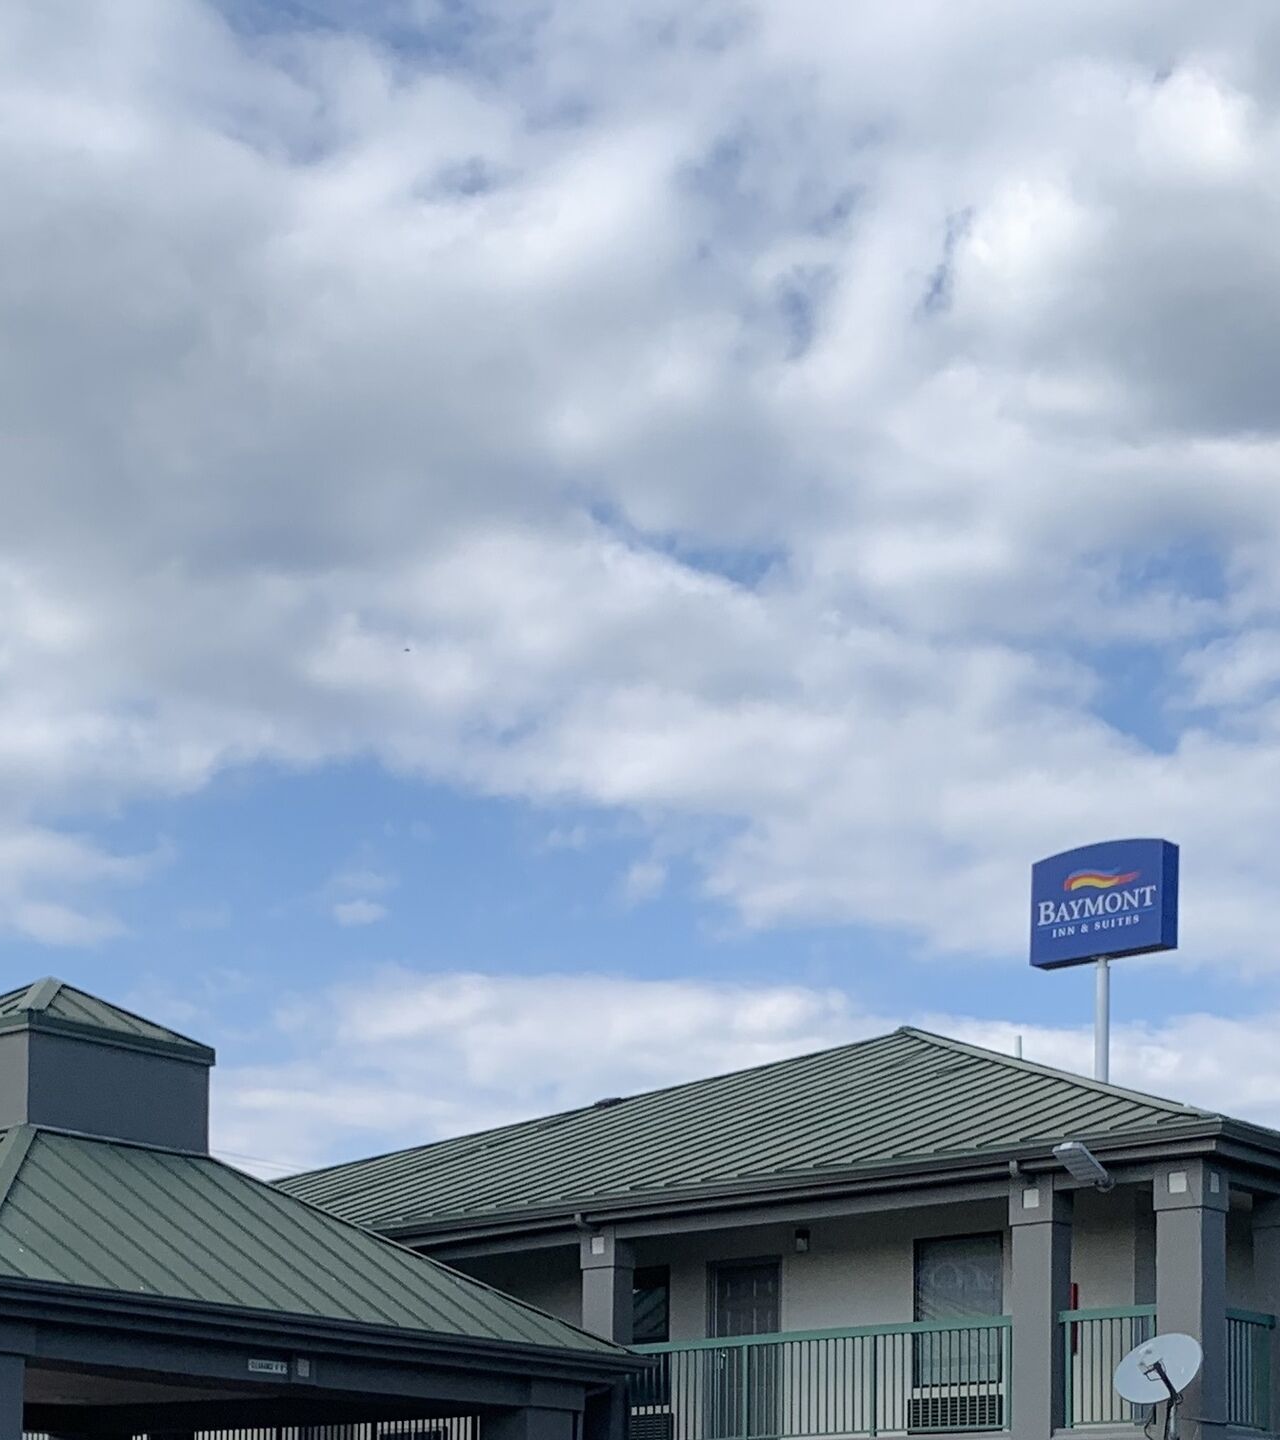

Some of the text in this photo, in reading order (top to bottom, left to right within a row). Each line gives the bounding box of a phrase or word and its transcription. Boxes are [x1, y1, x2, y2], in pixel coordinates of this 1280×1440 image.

[1037, 885, 1157, 926] BAYMONT
[1052, 914, 1140, 938] INN & SUITES
